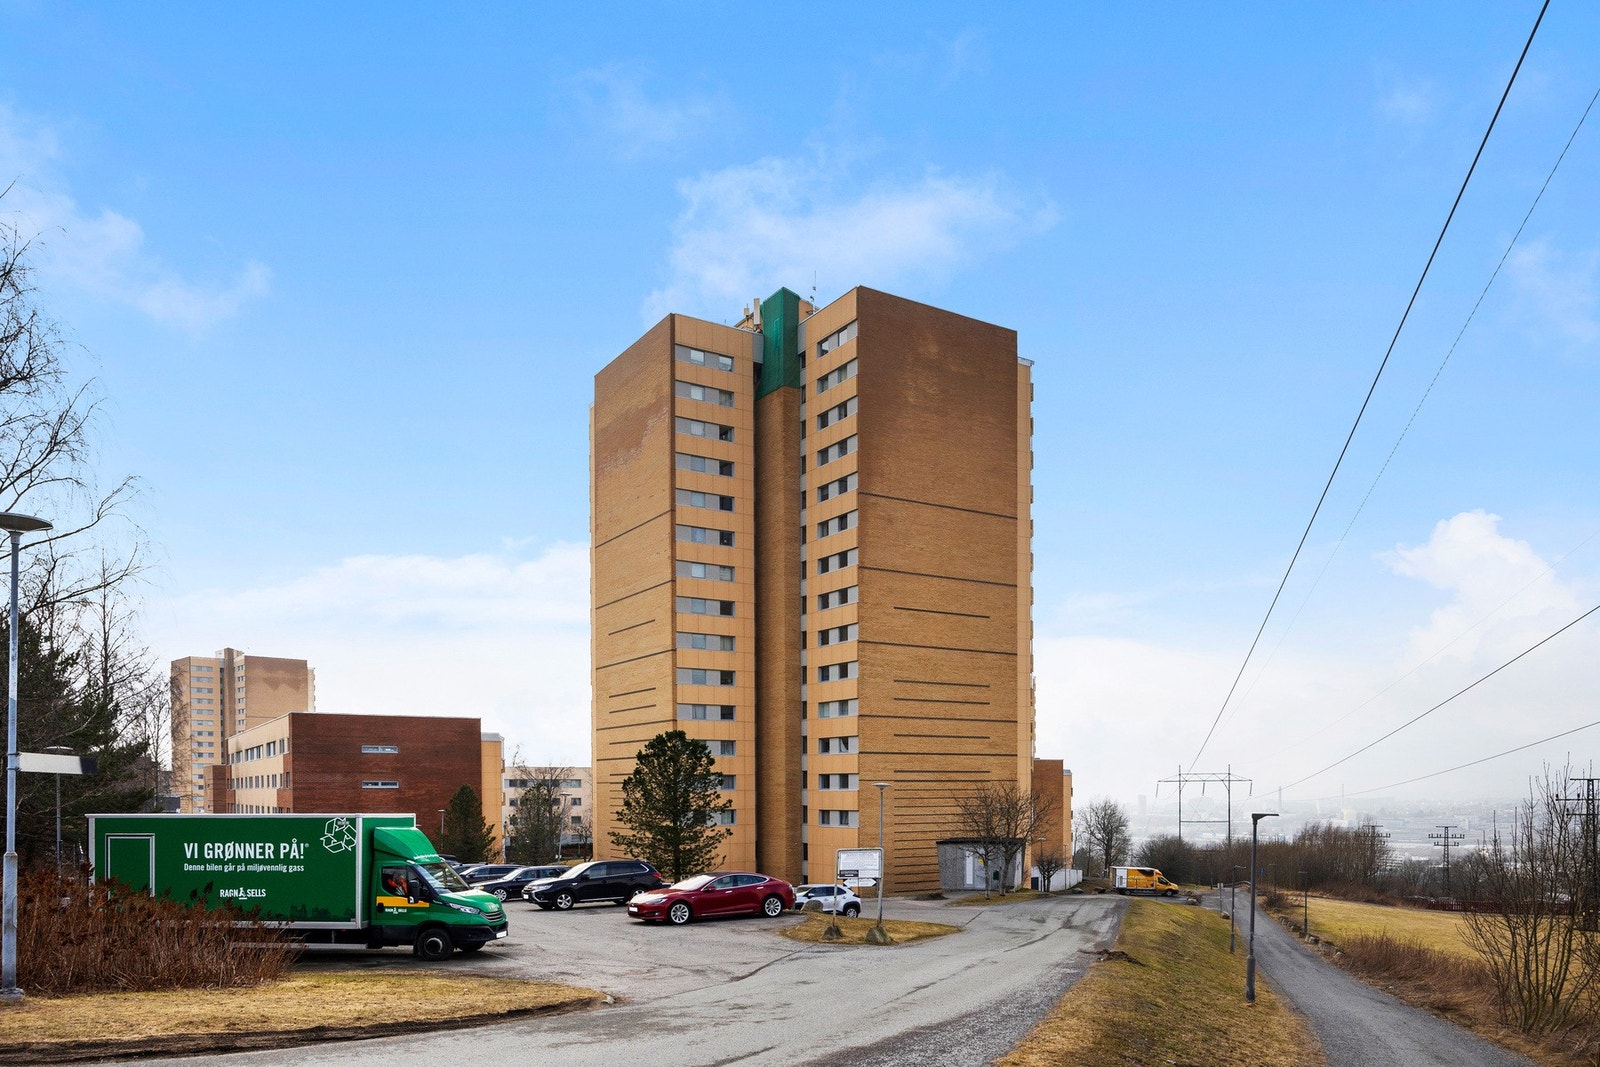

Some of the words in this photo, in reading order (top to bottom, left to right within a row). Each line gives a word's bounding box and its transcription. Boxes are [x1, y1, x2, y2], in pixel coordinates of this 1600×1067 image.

[184, 843, 198, 859] VI
[204, 841, 274, 861] GRØNNER
[184, 863, 205, 872] Denne
[206, 863, 223, 872] bilen
[224, 863, 235, 873] går
[237, 863, 246, 873] på
[247, 863, 287, 873] miljøvennlig
[288, 865, 305, 873] gass
